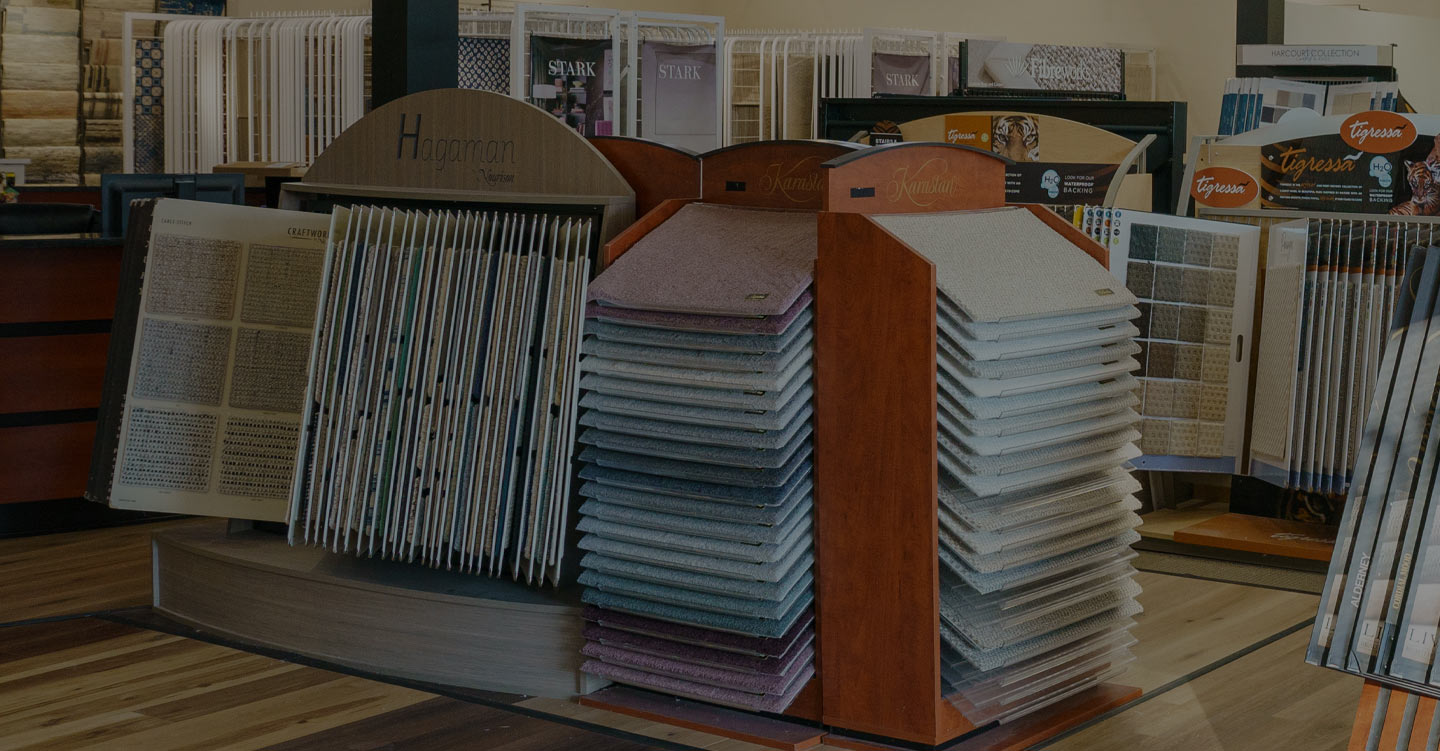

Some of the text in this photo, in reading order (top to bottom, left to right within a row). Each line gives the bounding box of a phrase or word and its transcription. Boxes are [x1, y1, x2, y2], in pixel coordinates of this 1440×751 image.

[1271, 49, 1360, 57] HARCOURT COLLECTION
[548, 60, 597, 77] STARK
[658, 64, 702, 80] STARK
[1030, 57, 1092, 81] Fibreworks
[886, 72, 920, 87] STARK
[397, 113, 516, 172] Hagaman
[760, 155, 824, 203] Karasta
[886, 157, 959, 207] Karastan
[287, 227, 330, 239] CRAFTWOR
[1350, 551, 1372, 609] ALDERNEY
